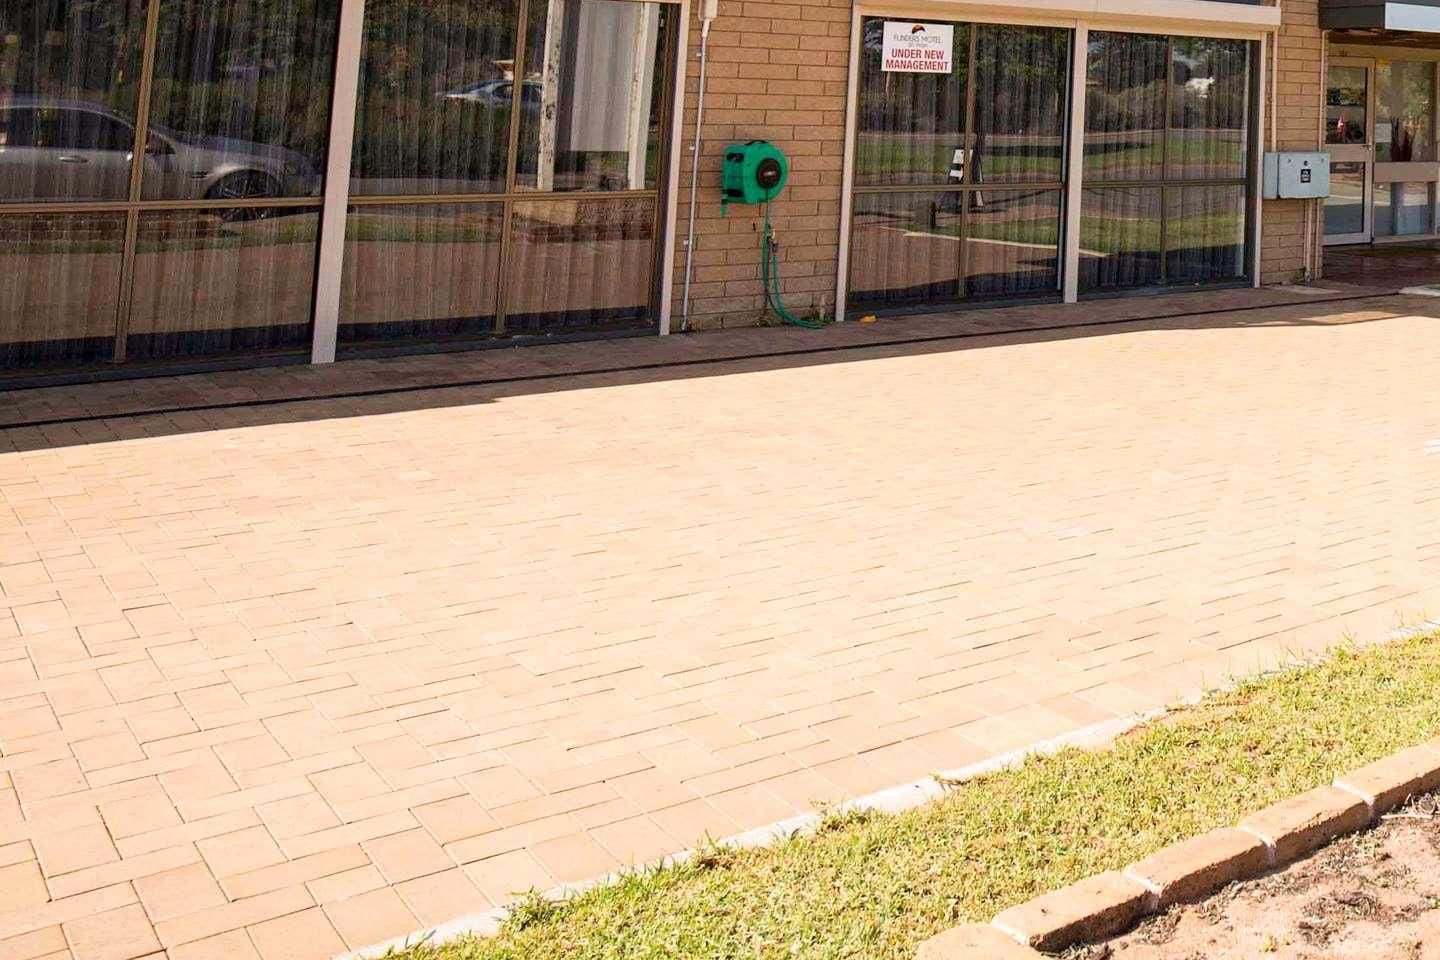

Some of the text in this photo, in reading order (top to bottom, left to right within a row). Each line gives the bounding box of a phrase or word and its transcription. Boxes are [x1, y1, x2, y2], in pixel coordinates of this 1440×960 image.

[891, 48, 945, 60] UNDER NEW
[885, 59, 949, 71] MANAGEMENT
